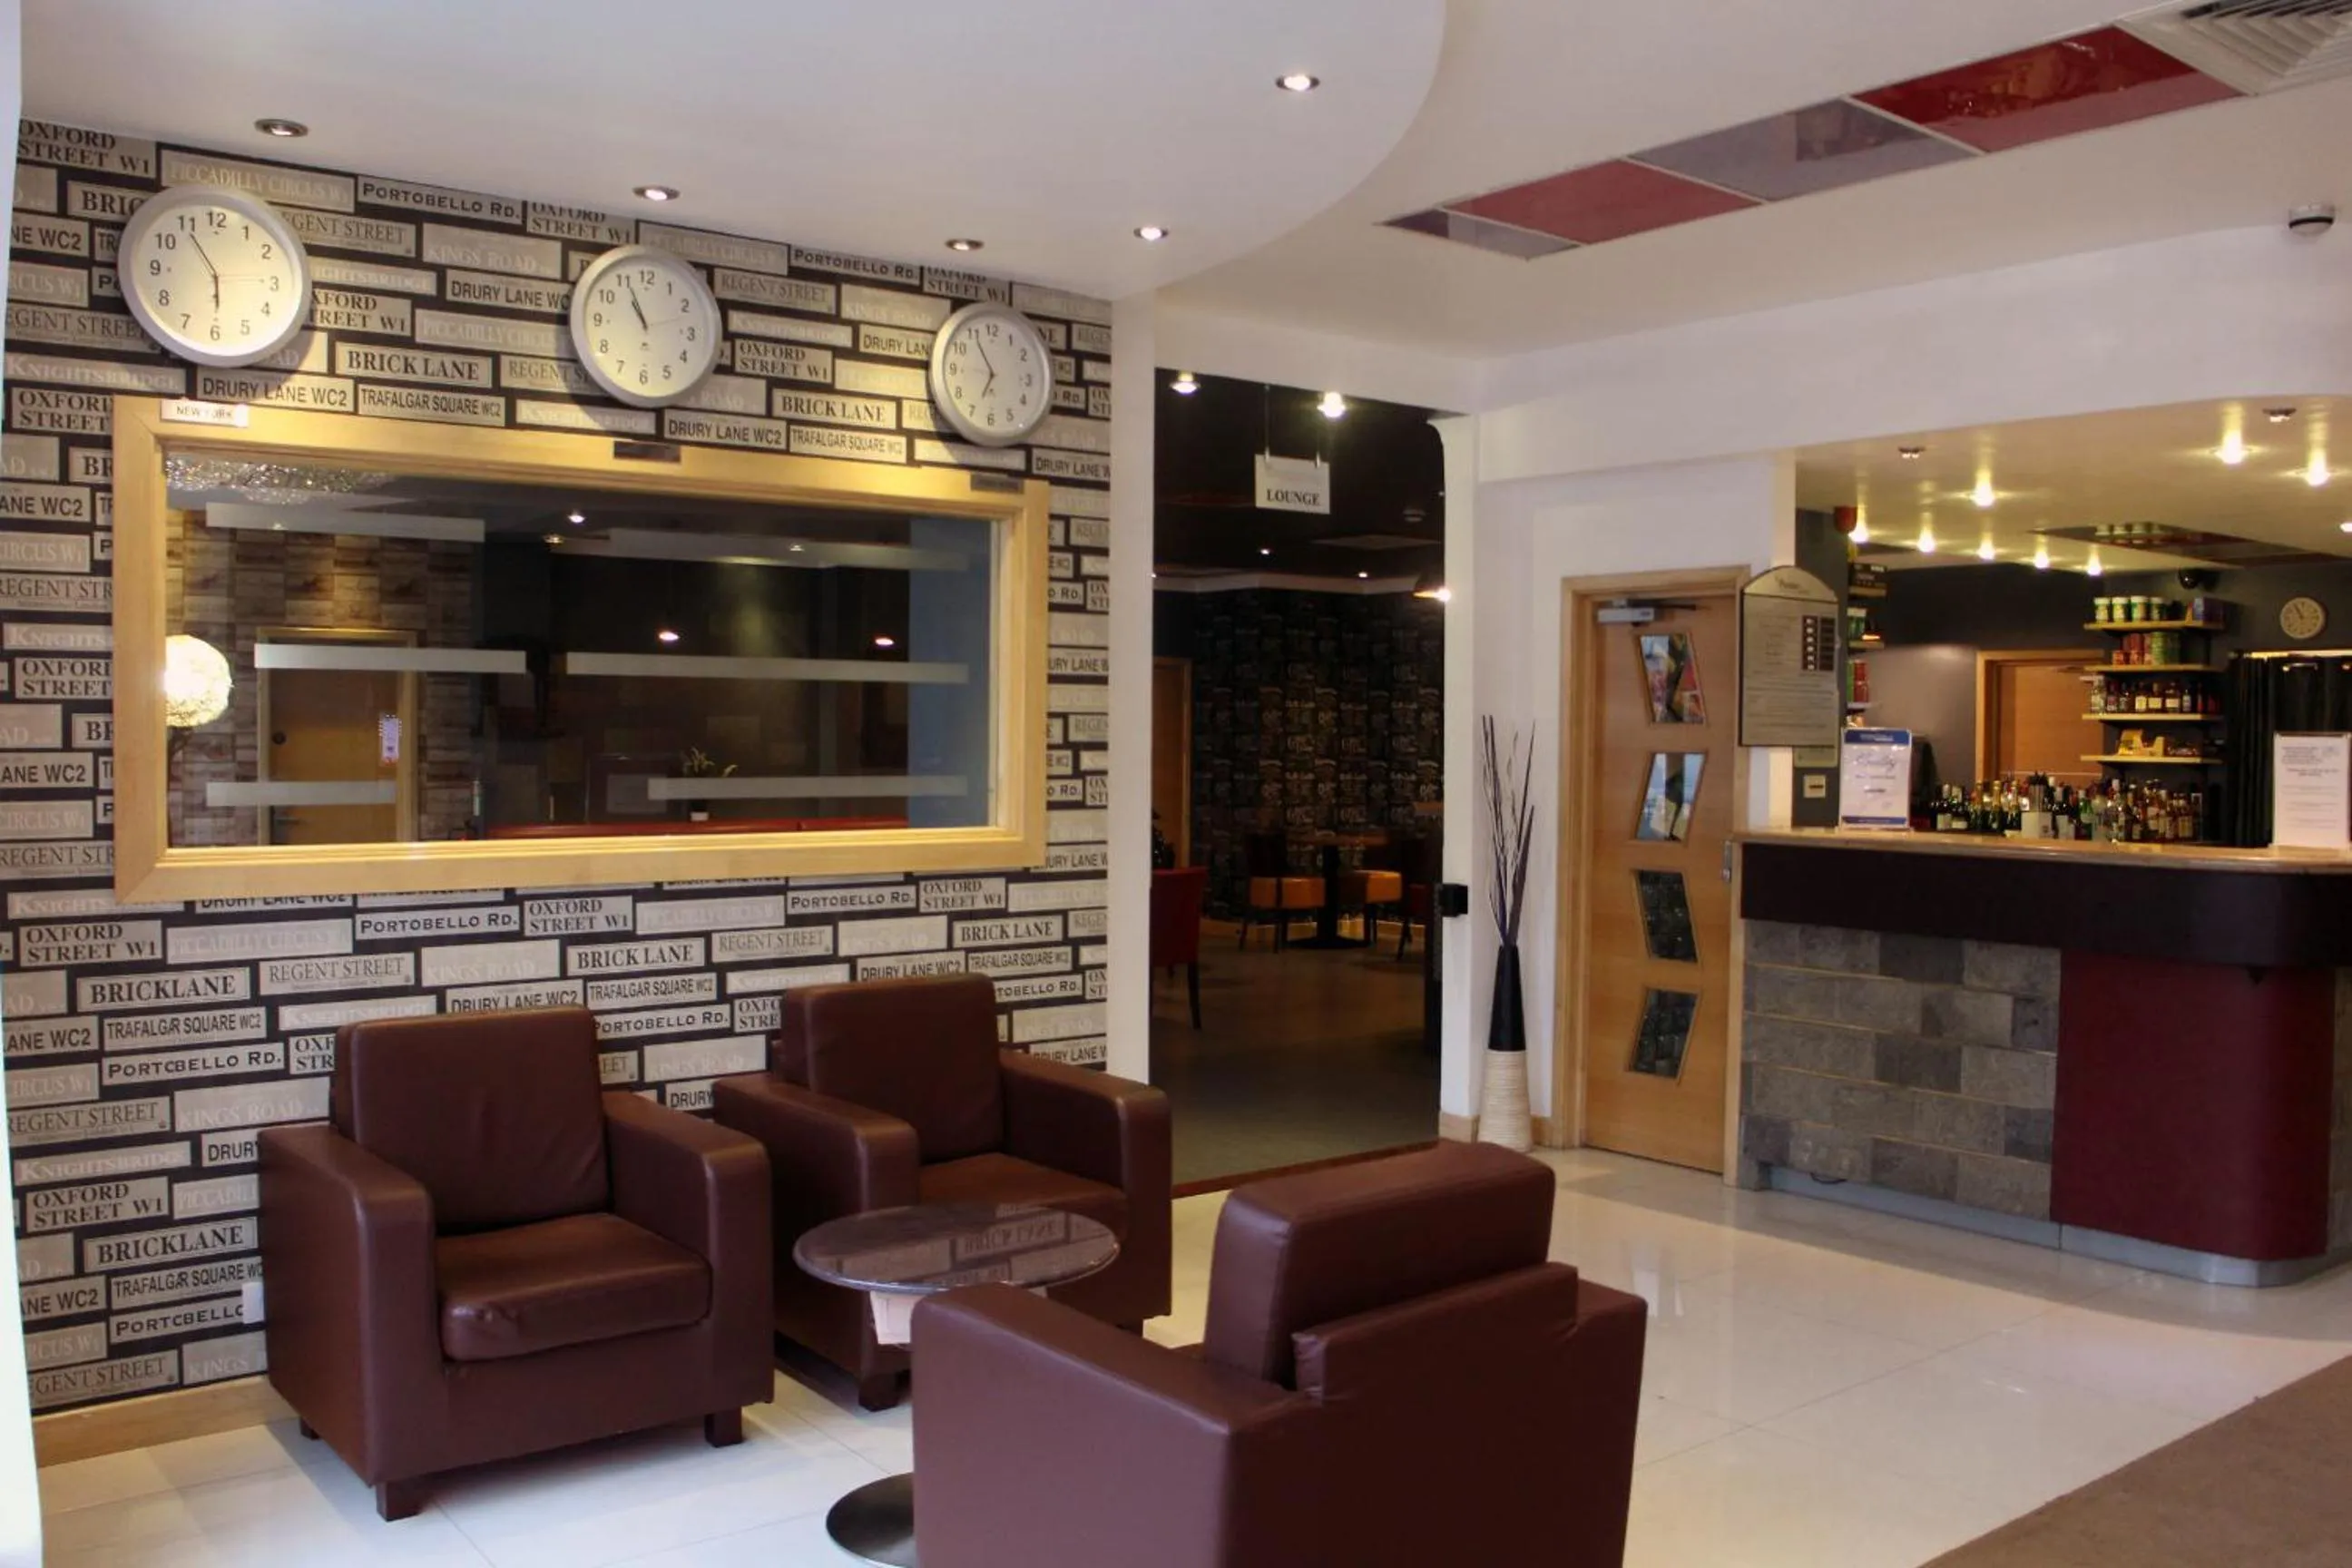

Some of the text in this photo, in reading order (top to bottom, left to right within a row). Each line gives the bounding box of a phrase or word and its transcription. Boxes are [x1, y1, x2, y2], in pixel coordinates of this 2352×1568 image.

[19, 119, 116, 150] OXFORD
[18, 141, 110, 168] STREET
[81, 189, 142, 218] BRIC
[363, 182, 483, 213] PORTOBELLO
[178, 215, 196, 233] 11
[206, 211, 227, 228] 12
[241, 225, 250, 240] 1
[345, 218, 404, 244] STREET
[532, 218, 600, 240] STREET
[38, 227, 81, 250] WC2
[155, 233, 176, 250] 10
[261, 244, 272, 259] 2
[150, 260, 162, 276] 9
[270, 275, 279, 290] 3
[616, 274, 631, 289] 11
[639, 270, 655, 285] 12
[451, 280, 542, 307] DRURY LANE
[598, 289, 614, 304] 10
[667, 282, 672, 295] 1
[779, 279, 828, 302] STREET
[927, 279, 983, 300] STREET
[159, 289, 170, 307] 8
[312, 289, 377, 311] XFORD
[681, 298, 690, 312] 2
[260, 302, 271, 316] 4
[181, 314, 191, 329] 7
[240, 319, 250, 335] 5
[593, 312, 603, 327] 9
[210, 325, 220, 341] 6
[686, 326, 696, 342] 3
[967, 328, 981, 340] 11
[985, 325, 999, 338] 12
[1008, 334, 1014, 347] 1
[599, 339, 609, 354] 8
[740, 342, 806, 361] OXFORD
[863, 334, 902, 352] DRURY
[953, 341, 967, 355] 10
[680, 349, 688, 364] 4
[1019, 348, 1028, 362] 2
[348, 349, 479, 380] BRICK LANE
[616, 360, 625, 374] 7
[662, 364, 671, 379] 5
[740, 358, 799, 377] STREET
[949, 362, 957, 376] 9
[639, 370, 648, 386] 6
[1024, 374, 1033, 387] 3
[203, 377, 347, 407] DRURY LANE WC2
[955, 387, 963, 399] 8
[1019, 394, 1027, 407] 4
[361, 388, 431, 410] TRAFALGAR
[431, 397, 478, 415] SQUARE
[782, 397, 886, 422] BRICK LANE
[968, 405, 976, 416] 7
[20, 411, 110, 432] STREET
[987, 414, 995, 426] 6
[1005, 408, 1014, 422] 5
[669, 419, 782, 445] DRURY LANE WC2
[792, 428, 847, 448] TRAFALGAR
[1035, 456, 1100, 477] DRURY LANE
[1266, 488, 1320, 506] LOUNGE
[41, 497, 83, 516] WC2
[44, 764, 86, 783] WC2
[923, 879, 983, 894] OXFORD
[529, 899, 603, 916] OXFORD
[791, 894, 886, 909] PORTOBELLO
[923, 894, 978, 909] STREET
[361, 915, 480, 935] PORTOBELLO
[529, 916, 597, 933] STREET
[961, 920, 1054, 942] BRICK LANE
[26, 924, 122, 945] OXFORD
[719, 932, 773, 952] REGENT
[777, 929, 825, 947] STREET
[27, 943, 116, 964] STREET
[577, 944, 693, 969] BRICK LANE
[269, 956, 404, 983] REGENT STREET
[590, 981, 651, 1000] TRAFALGAR
[652, 978, 694, 997] SQUARE
[107, 1014, 262, 1040] TRAFALGAR SQUARE WC2
[50, 1027, 91, 1049] WC2
[88, 1102, 159, 1126] STREET
[208, 1142, 259, 1162] DRUR
[33, 1183, 130, 1209] OXFORD
[34, 1203, 122, 1228] STREET
[113, 1264, 244, 1298] TRAFALGAR SQUARE
[57, 1289, 99, 1309] WC2
[95, 1357, 166, 1383] STREET
